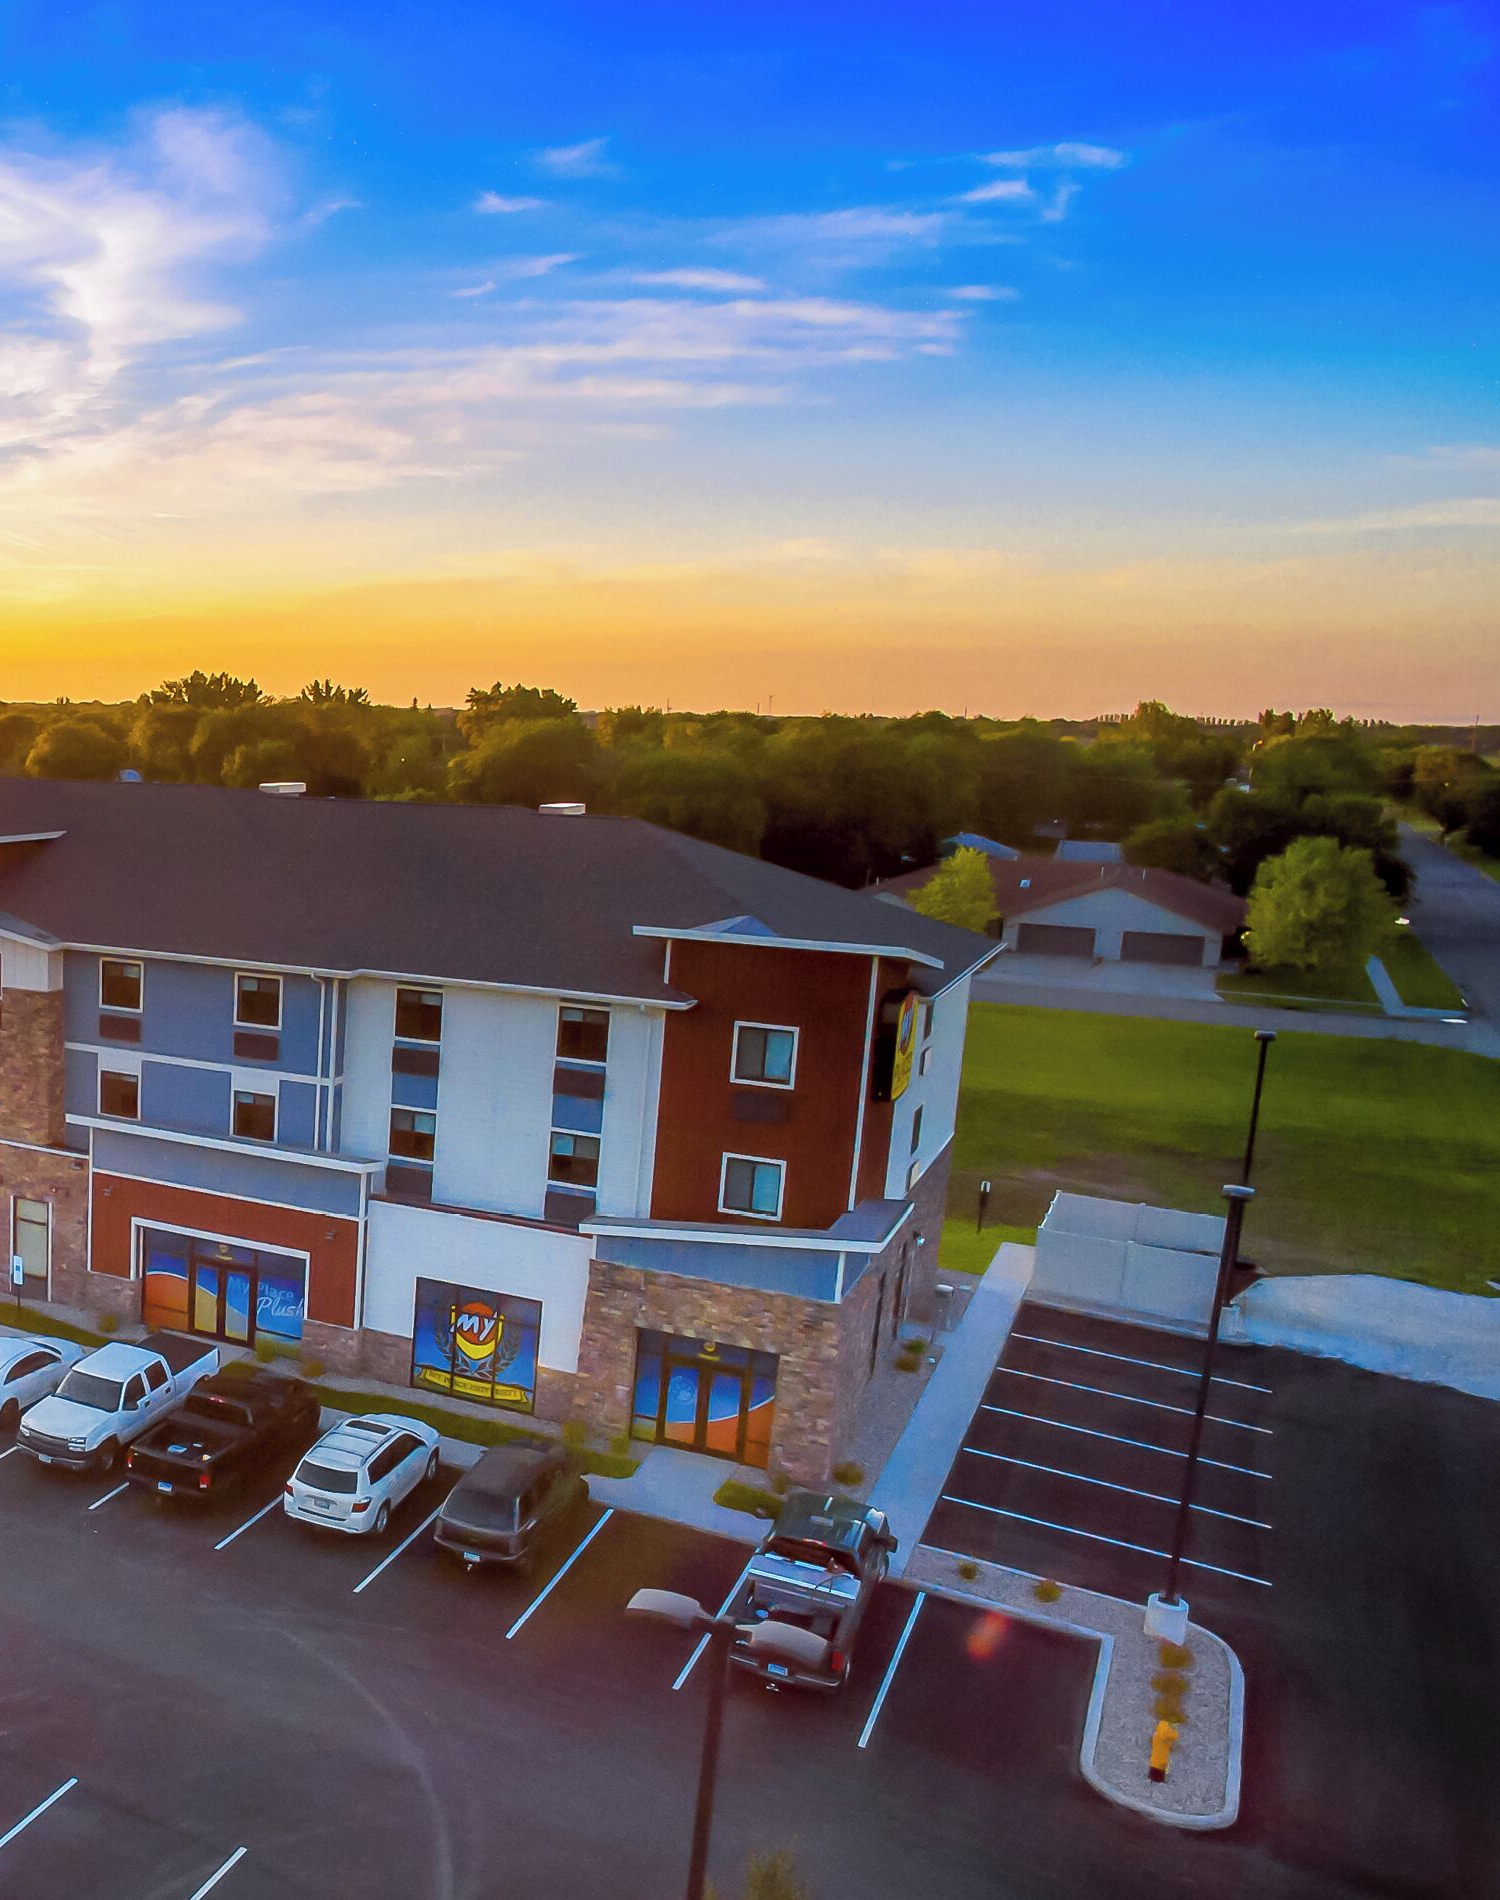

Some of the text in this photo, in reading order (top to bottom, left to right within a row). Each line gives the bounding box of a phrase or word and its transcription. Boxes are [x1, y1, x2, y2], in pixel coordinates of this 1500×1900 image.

[228, 1276, 294, 1301] My Place
[256, 1295, 305, 1318] Plush
